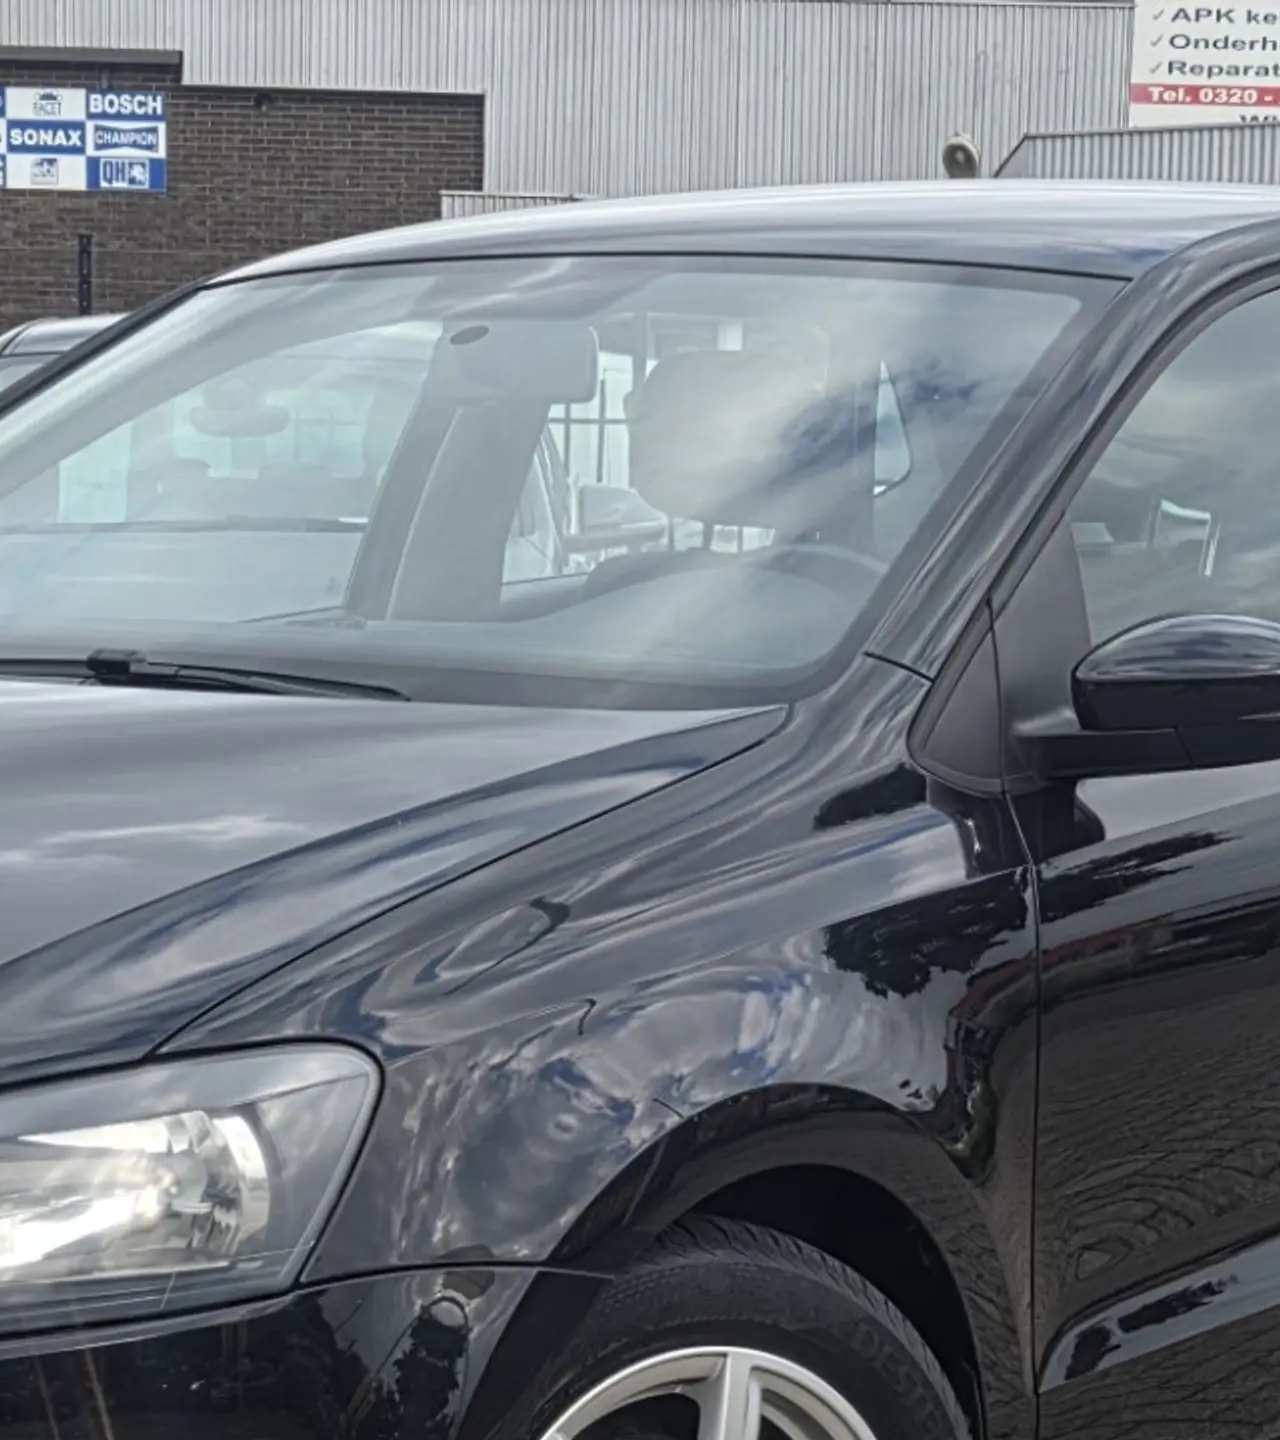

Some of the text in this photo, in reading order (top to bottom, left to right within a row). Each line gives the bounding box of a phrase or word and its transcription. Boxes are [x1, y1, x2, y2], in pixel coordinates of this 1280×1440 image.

[1171, 8, 1236, 24] APK
[89, 93, 163, 115] BOSCH
[1148, 86, 1191, 103] Tel.
[1199, 87, 1257, 105] 0320
[10, 128, 81, 147] SONAX
[95, 131, 157, 146] CHAMPION
